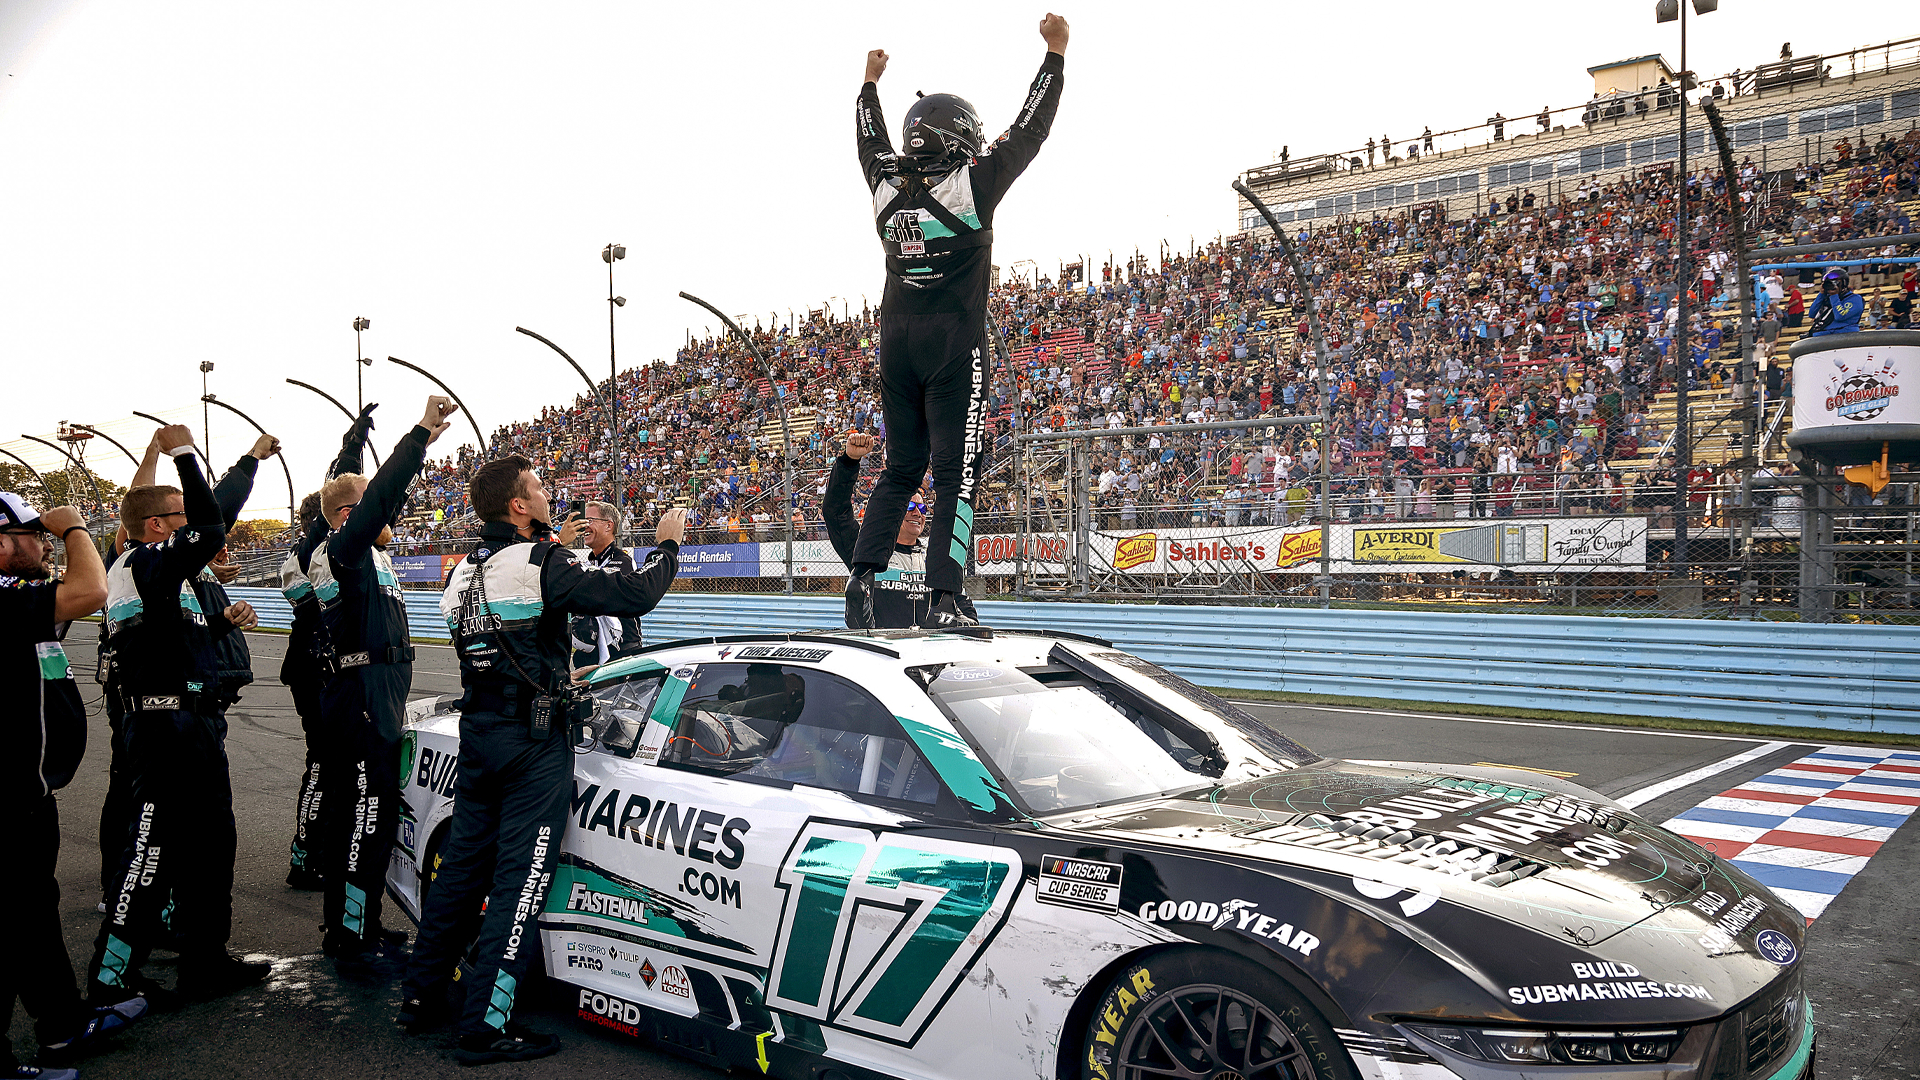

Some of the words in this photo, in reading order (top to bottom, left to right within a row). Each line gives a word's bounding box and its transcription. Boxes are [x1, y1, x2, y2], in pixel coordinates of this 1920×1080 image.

[1019, 73, 1054, 129] SUBMARINES.COM
[892, 213, 919, 228] WE
[886, 227, 925, 242] BUILD
[1826, 395, 1844, 411] GO
[1845, 385, 1899, 404] BOWLING
[1839, 407, 1849, 415] AT
[1851, 403, 1867, 412] THE
[1868, 399, 1889, 408] GLEN
[958, 347, 983, 500] SUBMARINES.COM
[1117, 539, 1154, 562] Sahlen's
[1169, 541, 1265, 561] Sahlen's
[1360, 531, 1434, 551] A-VERDI
[1593, 530, 1634, 551] Owned
[700, 551, 732, 562] Rentals
[770, 647, 833, 659] BUESCHER
[953, 667, 994, 680] Ford
[308, 791, 323, 821] BUILD
[366, 797, 378, 834] BUILD
[1560, 833, 1637, 871] .COM
[113, 802, 155, 926] SUBMARINES.COM
[141, 846, 161, 886] BUILD
[1065, 861, 1111, 881] NASCAR
[503, 826, 551, 960] SUBMARINES.COM
[678, 867, 743, 909] .COM
[1048, 880, 1070, 894] CUP
[1070, 884, 1108, 901] SERIES
[566, 882, 648, 924] FASTENAL
[1692, 890, 1728, 917] BUILD
[766, 820, 1022, 1046] 17
[578, 942, 606, 956] SYSPRO
[619, 951, 640, 964] TULIP
[1760, 933, 1793, 962] Ford
[610, 968, 631, 979] SIEMENS
[1570, 961, 1641, 979] BUILD
[662, 983, 689, 997] TOOLS
[1508, 981, 1714, 1005] SUBMARINES.COM
[579, 989, 641, 1025] FORD
[578, 1009, 639, 1037] PERFORMANCE
